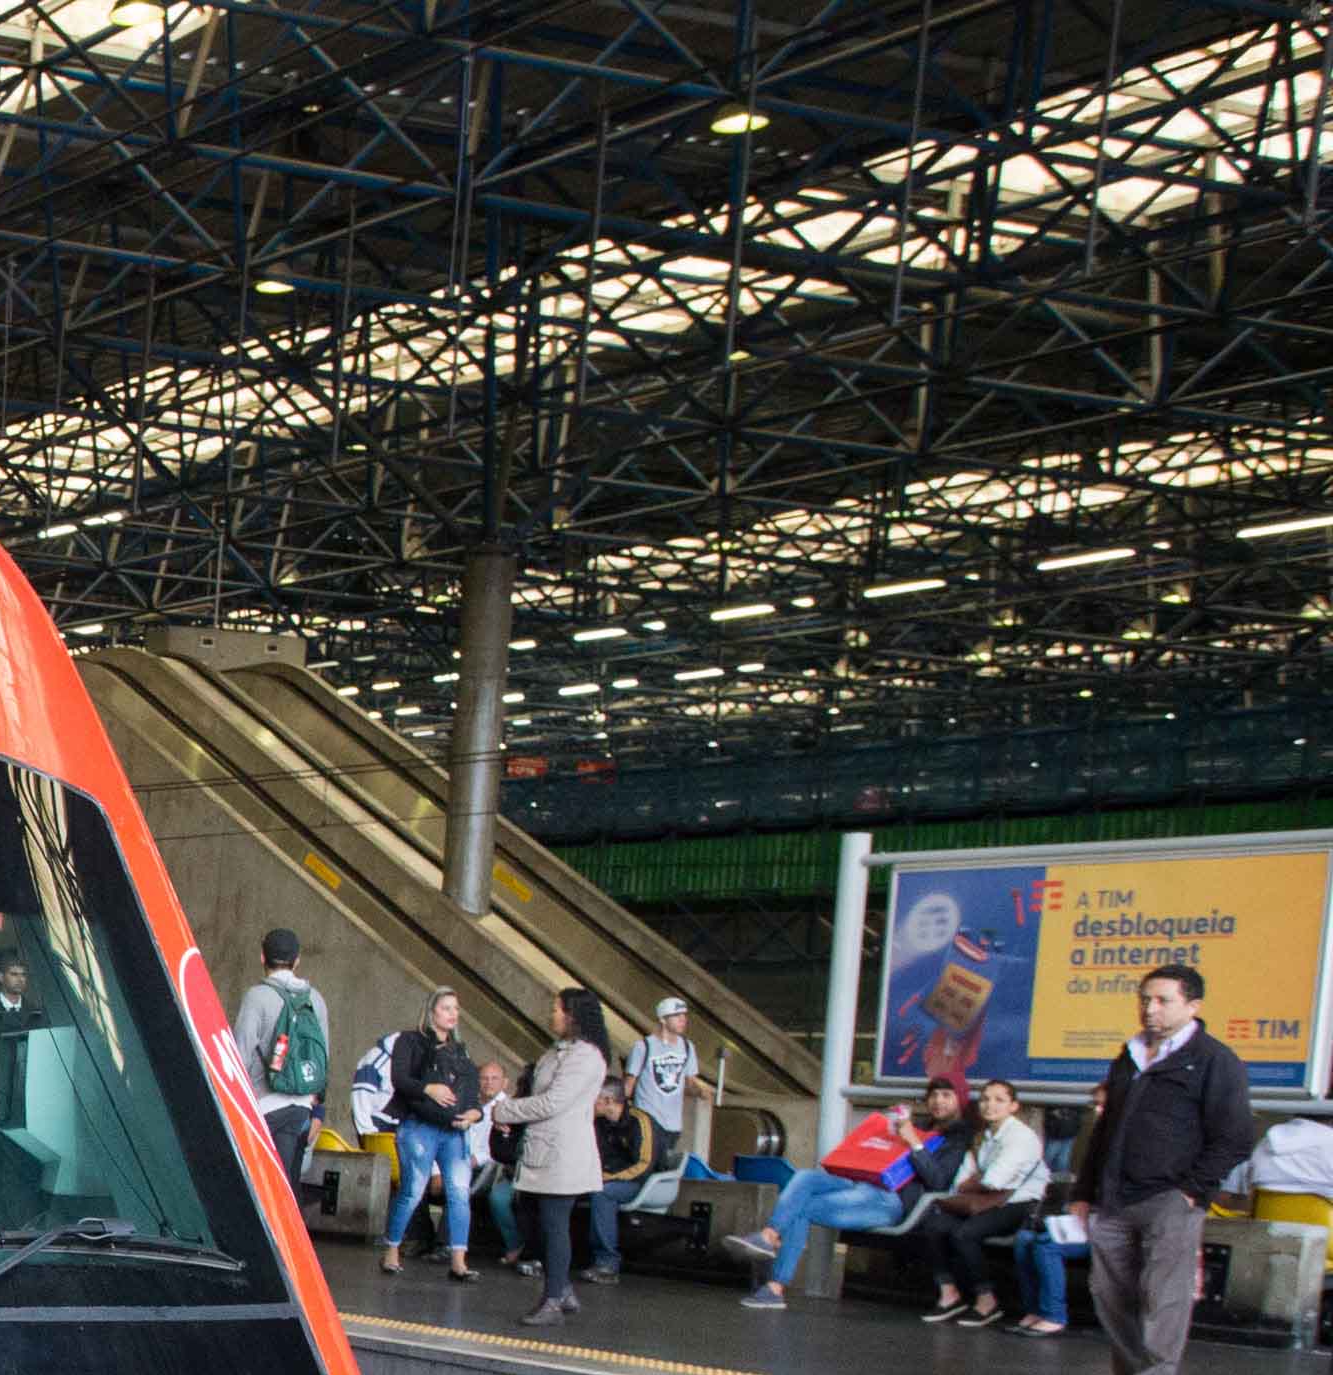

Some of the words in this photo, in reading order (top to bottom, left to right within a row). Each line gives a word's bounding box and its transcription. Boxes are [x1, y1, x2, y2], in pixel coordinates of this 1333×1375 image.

[1074, 892, 1090, 910] A
[1097, 889, 1135, 909] TIM
[1073, 910, 1237, 941] desbloqueia
[1070, 950, 1086, 966] a
[1092, 942, 1201, 966] internet
[1066, 974, 1090, 995] do
[1255, 1019, 1300, 1040] TIM
